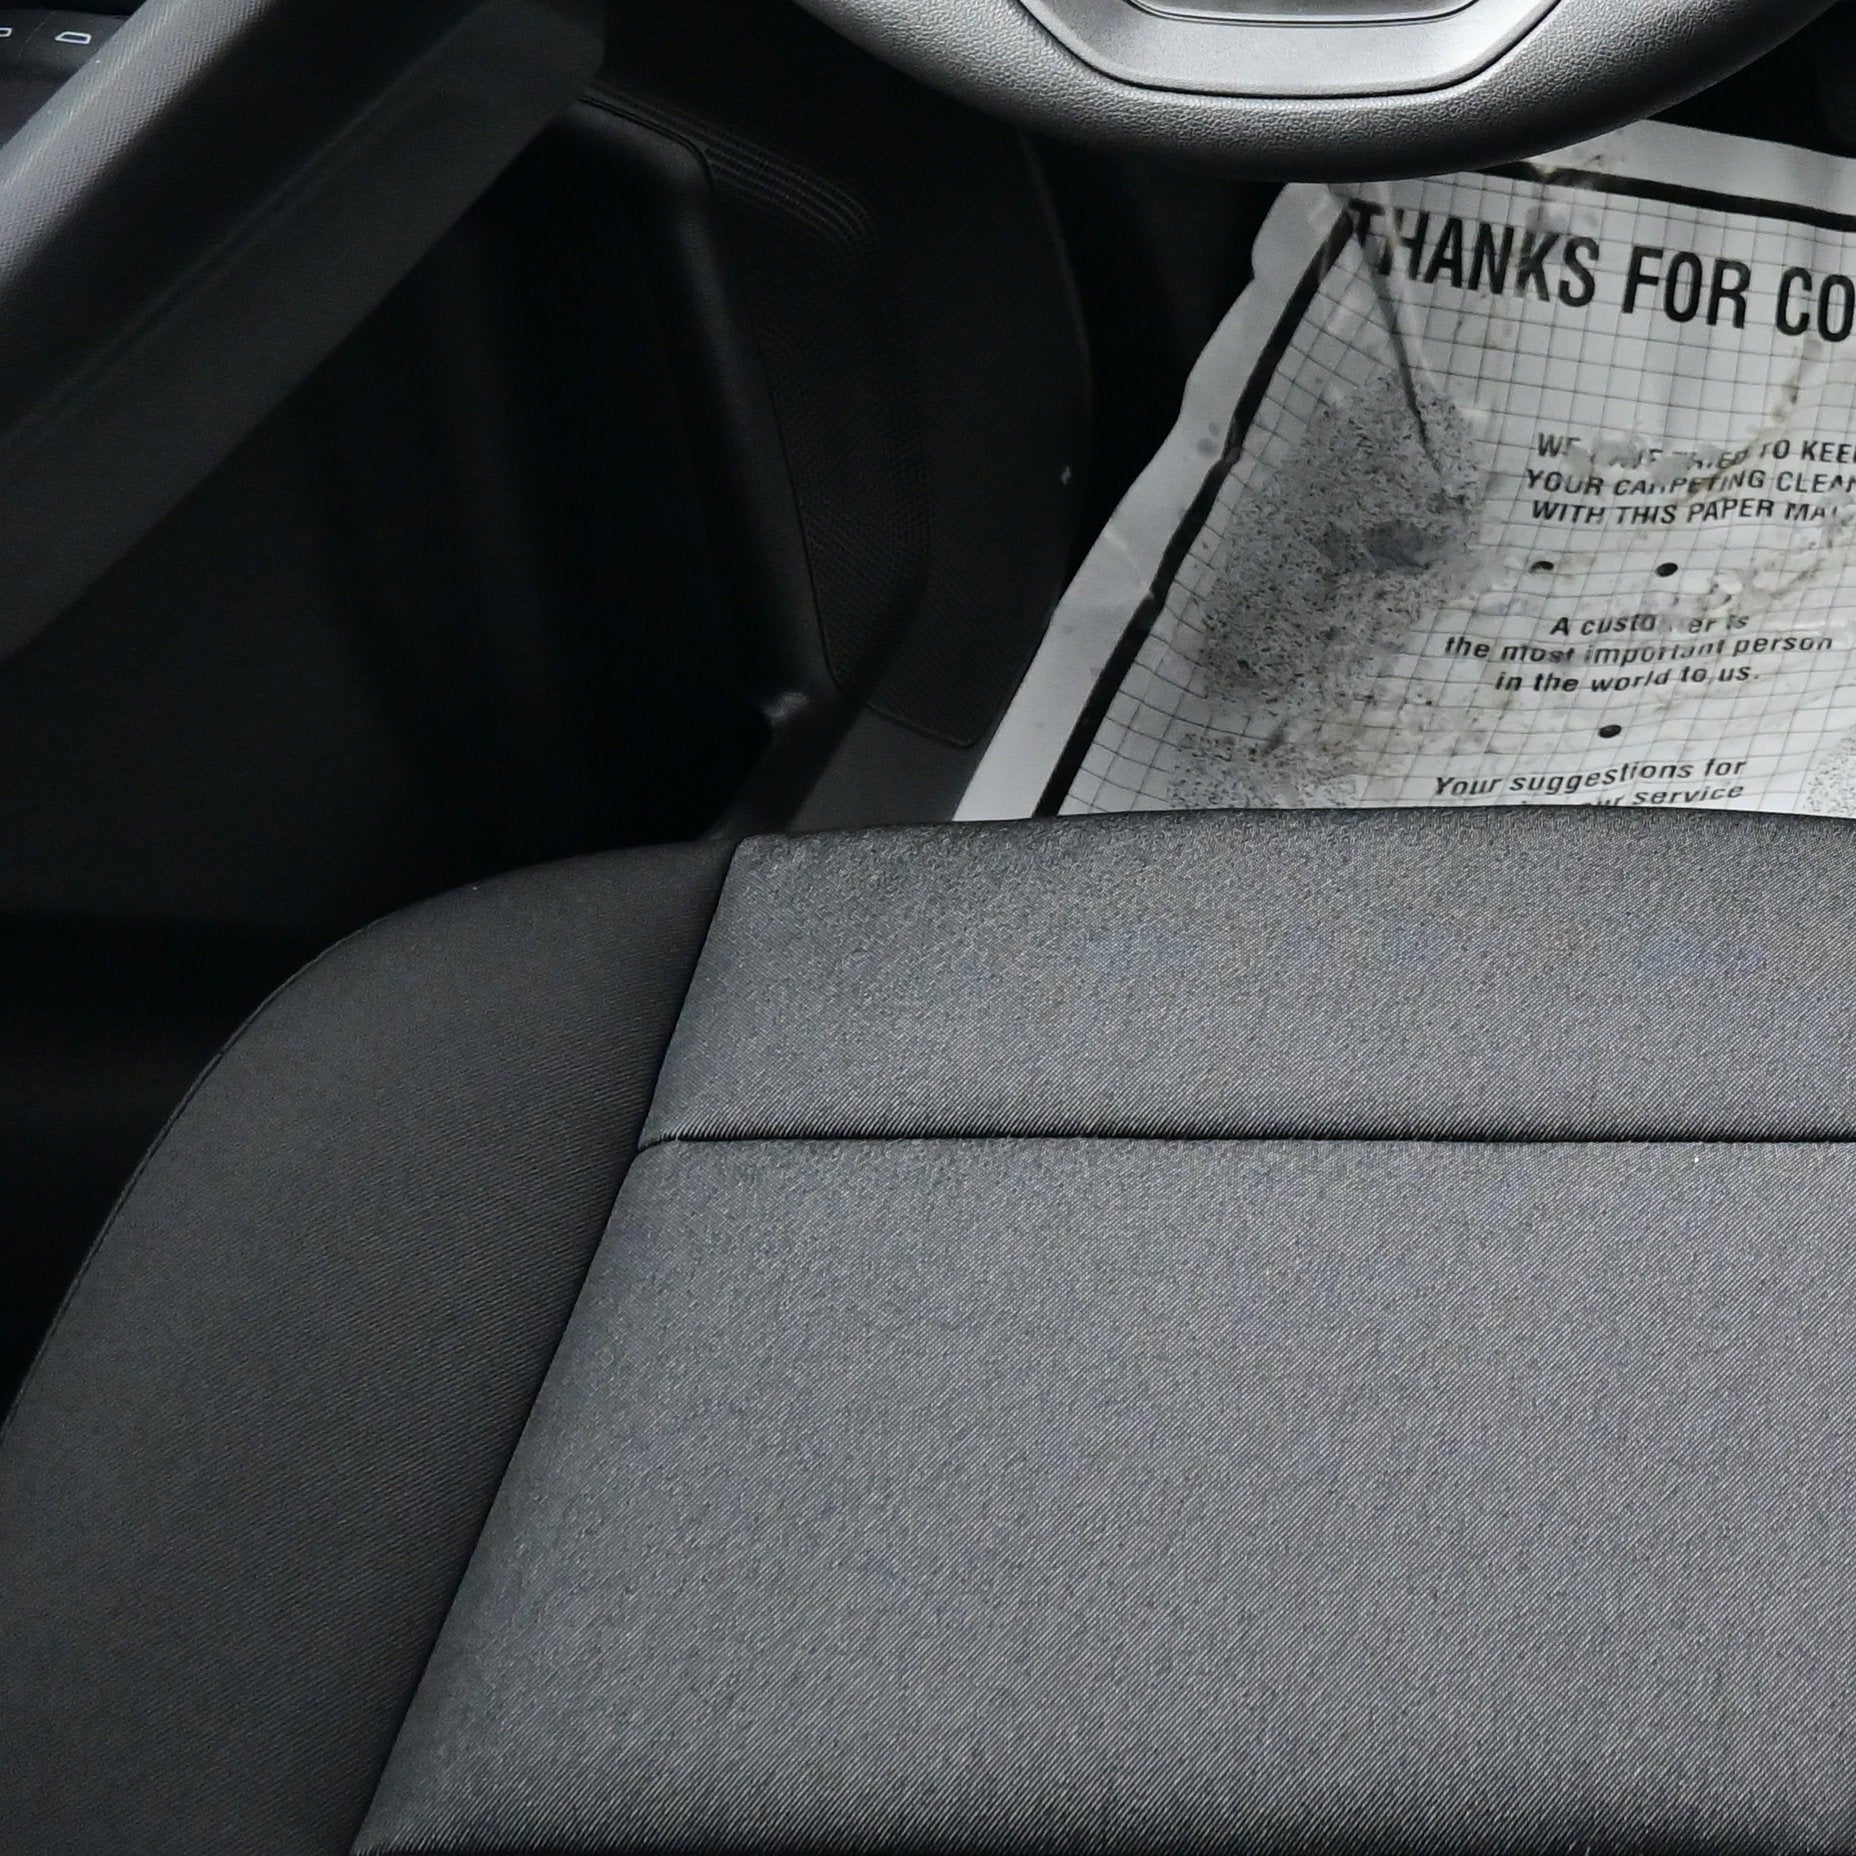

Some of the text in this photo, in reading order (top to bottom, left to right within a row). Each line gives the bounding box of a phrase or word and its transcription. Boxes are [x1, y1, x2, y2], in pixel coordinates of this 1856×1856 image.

[1345, 197, 1601, 310] THANKS
[1620, 243, 1753, 331] FOR
[1524, 467, 1604, 496] YOUR
[1530, 497, 1775, 525] WITH THIS PAPER
[1444, 635, 1835, 659] the person
[1494, 664, 1760, 694] in the world to us.
[1434, 756, 1747, 799] Your suggestions for
